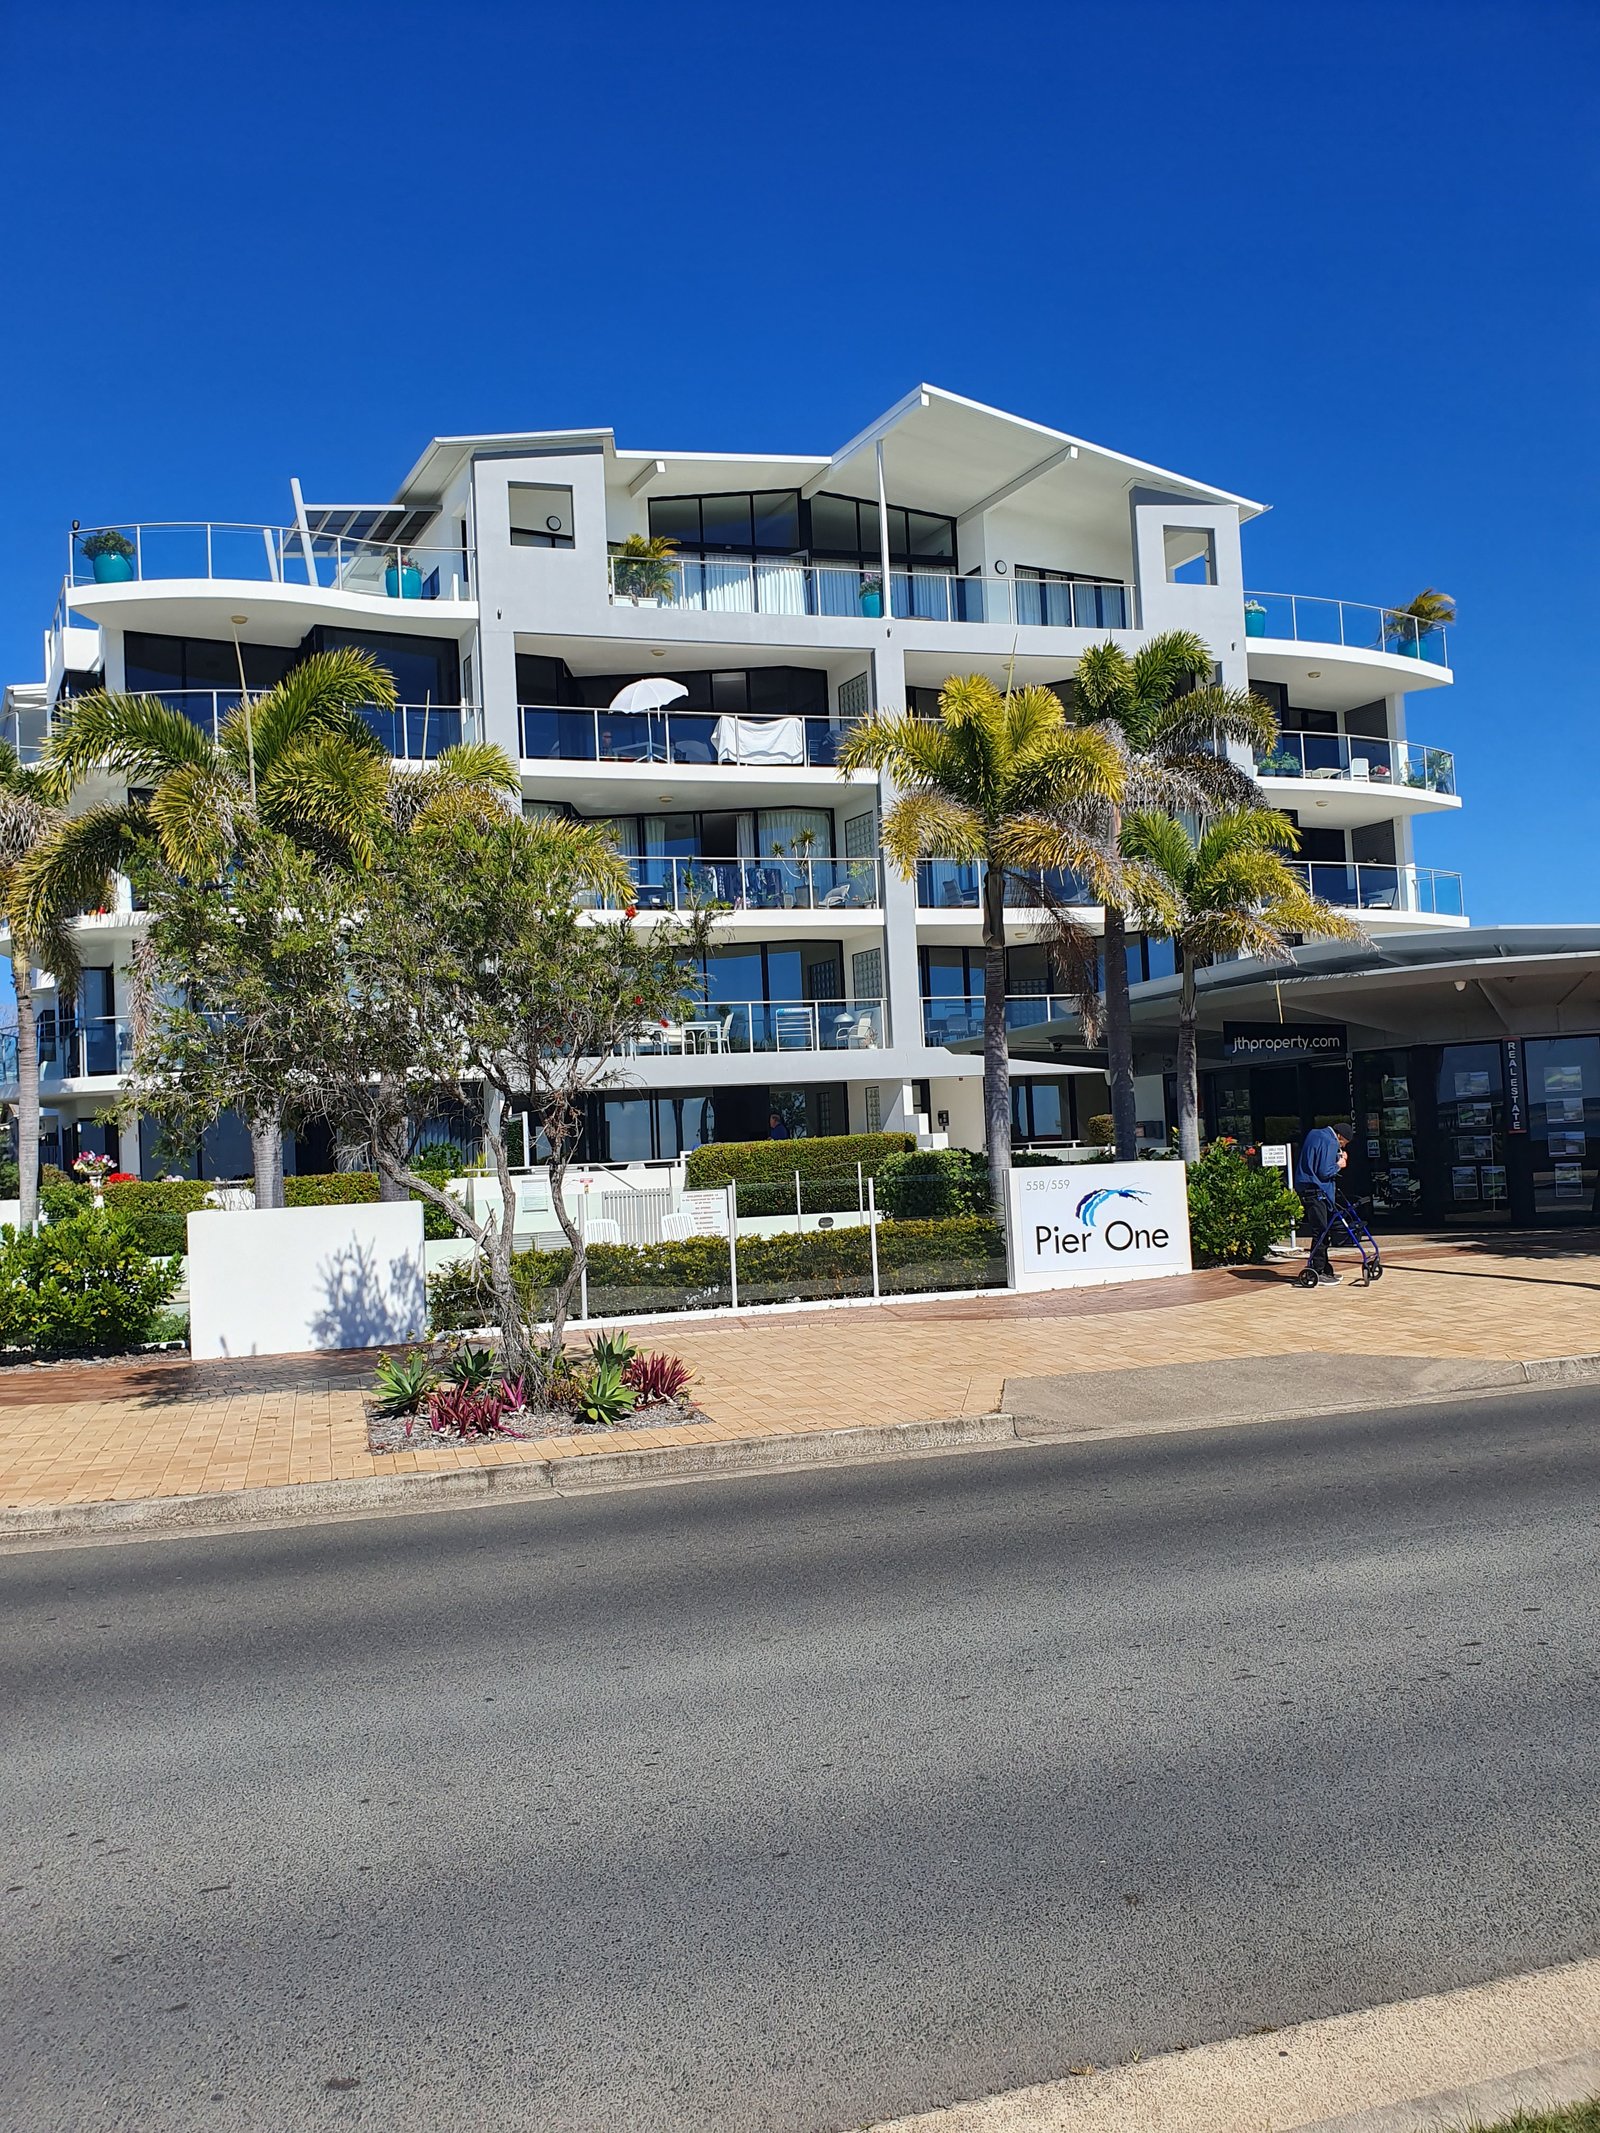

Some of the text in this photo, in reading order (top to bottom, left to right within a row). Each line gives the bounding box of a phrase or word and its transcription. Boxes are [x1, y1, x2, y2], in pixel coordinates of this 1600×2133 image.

[1232, 1035, 1340, 1054] jthproperty.com
[1347, 1059, 1356, 1133] OFFICE
[1507, 1042, 1520, 1129] REAL ESTATE
[1025, 1179, 1070, 1192] 558/559
[1035, 1220, 1169, 1255] Pier One
